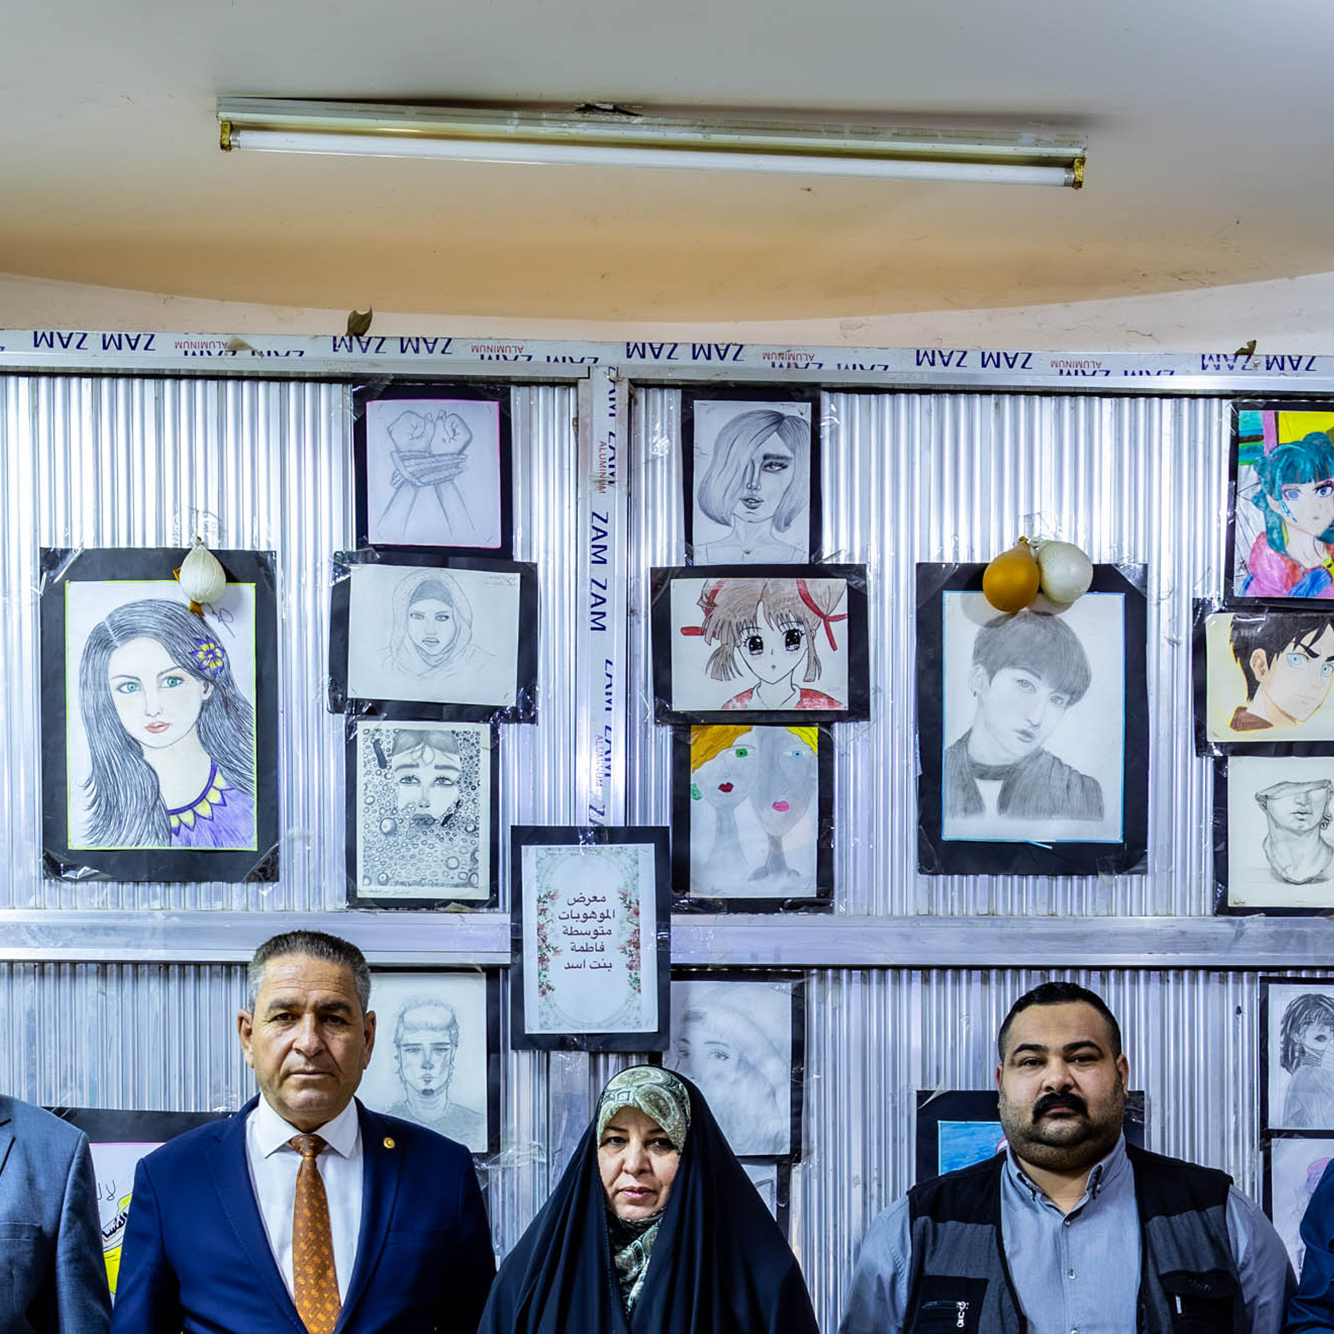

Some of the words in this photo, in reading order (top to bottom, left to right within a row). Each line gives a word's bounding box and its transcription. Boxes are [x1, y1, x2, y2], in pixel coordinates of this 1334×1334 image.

[33, 331, 88, 350] ZAM
[102, 332, 156, 351] ZAM
[400, 337, 453, 354] ZAM
[471, 344, 523, 353] ALUMINUM
[626, 341, 678, 359] ZAM
[692, 343, 745, 361] ZAM
[591, 511, 608, 564] ZAM
[590, 579, 607, 632] ZAM
[567, 892, 606, 906] معرض
[558, 909, 615, 923] الموهوبات
[562, 925, 612, 939] متوسطة
[570, 941, 605, 952] فاطمة
[589, 958, 612, 972] بنت
